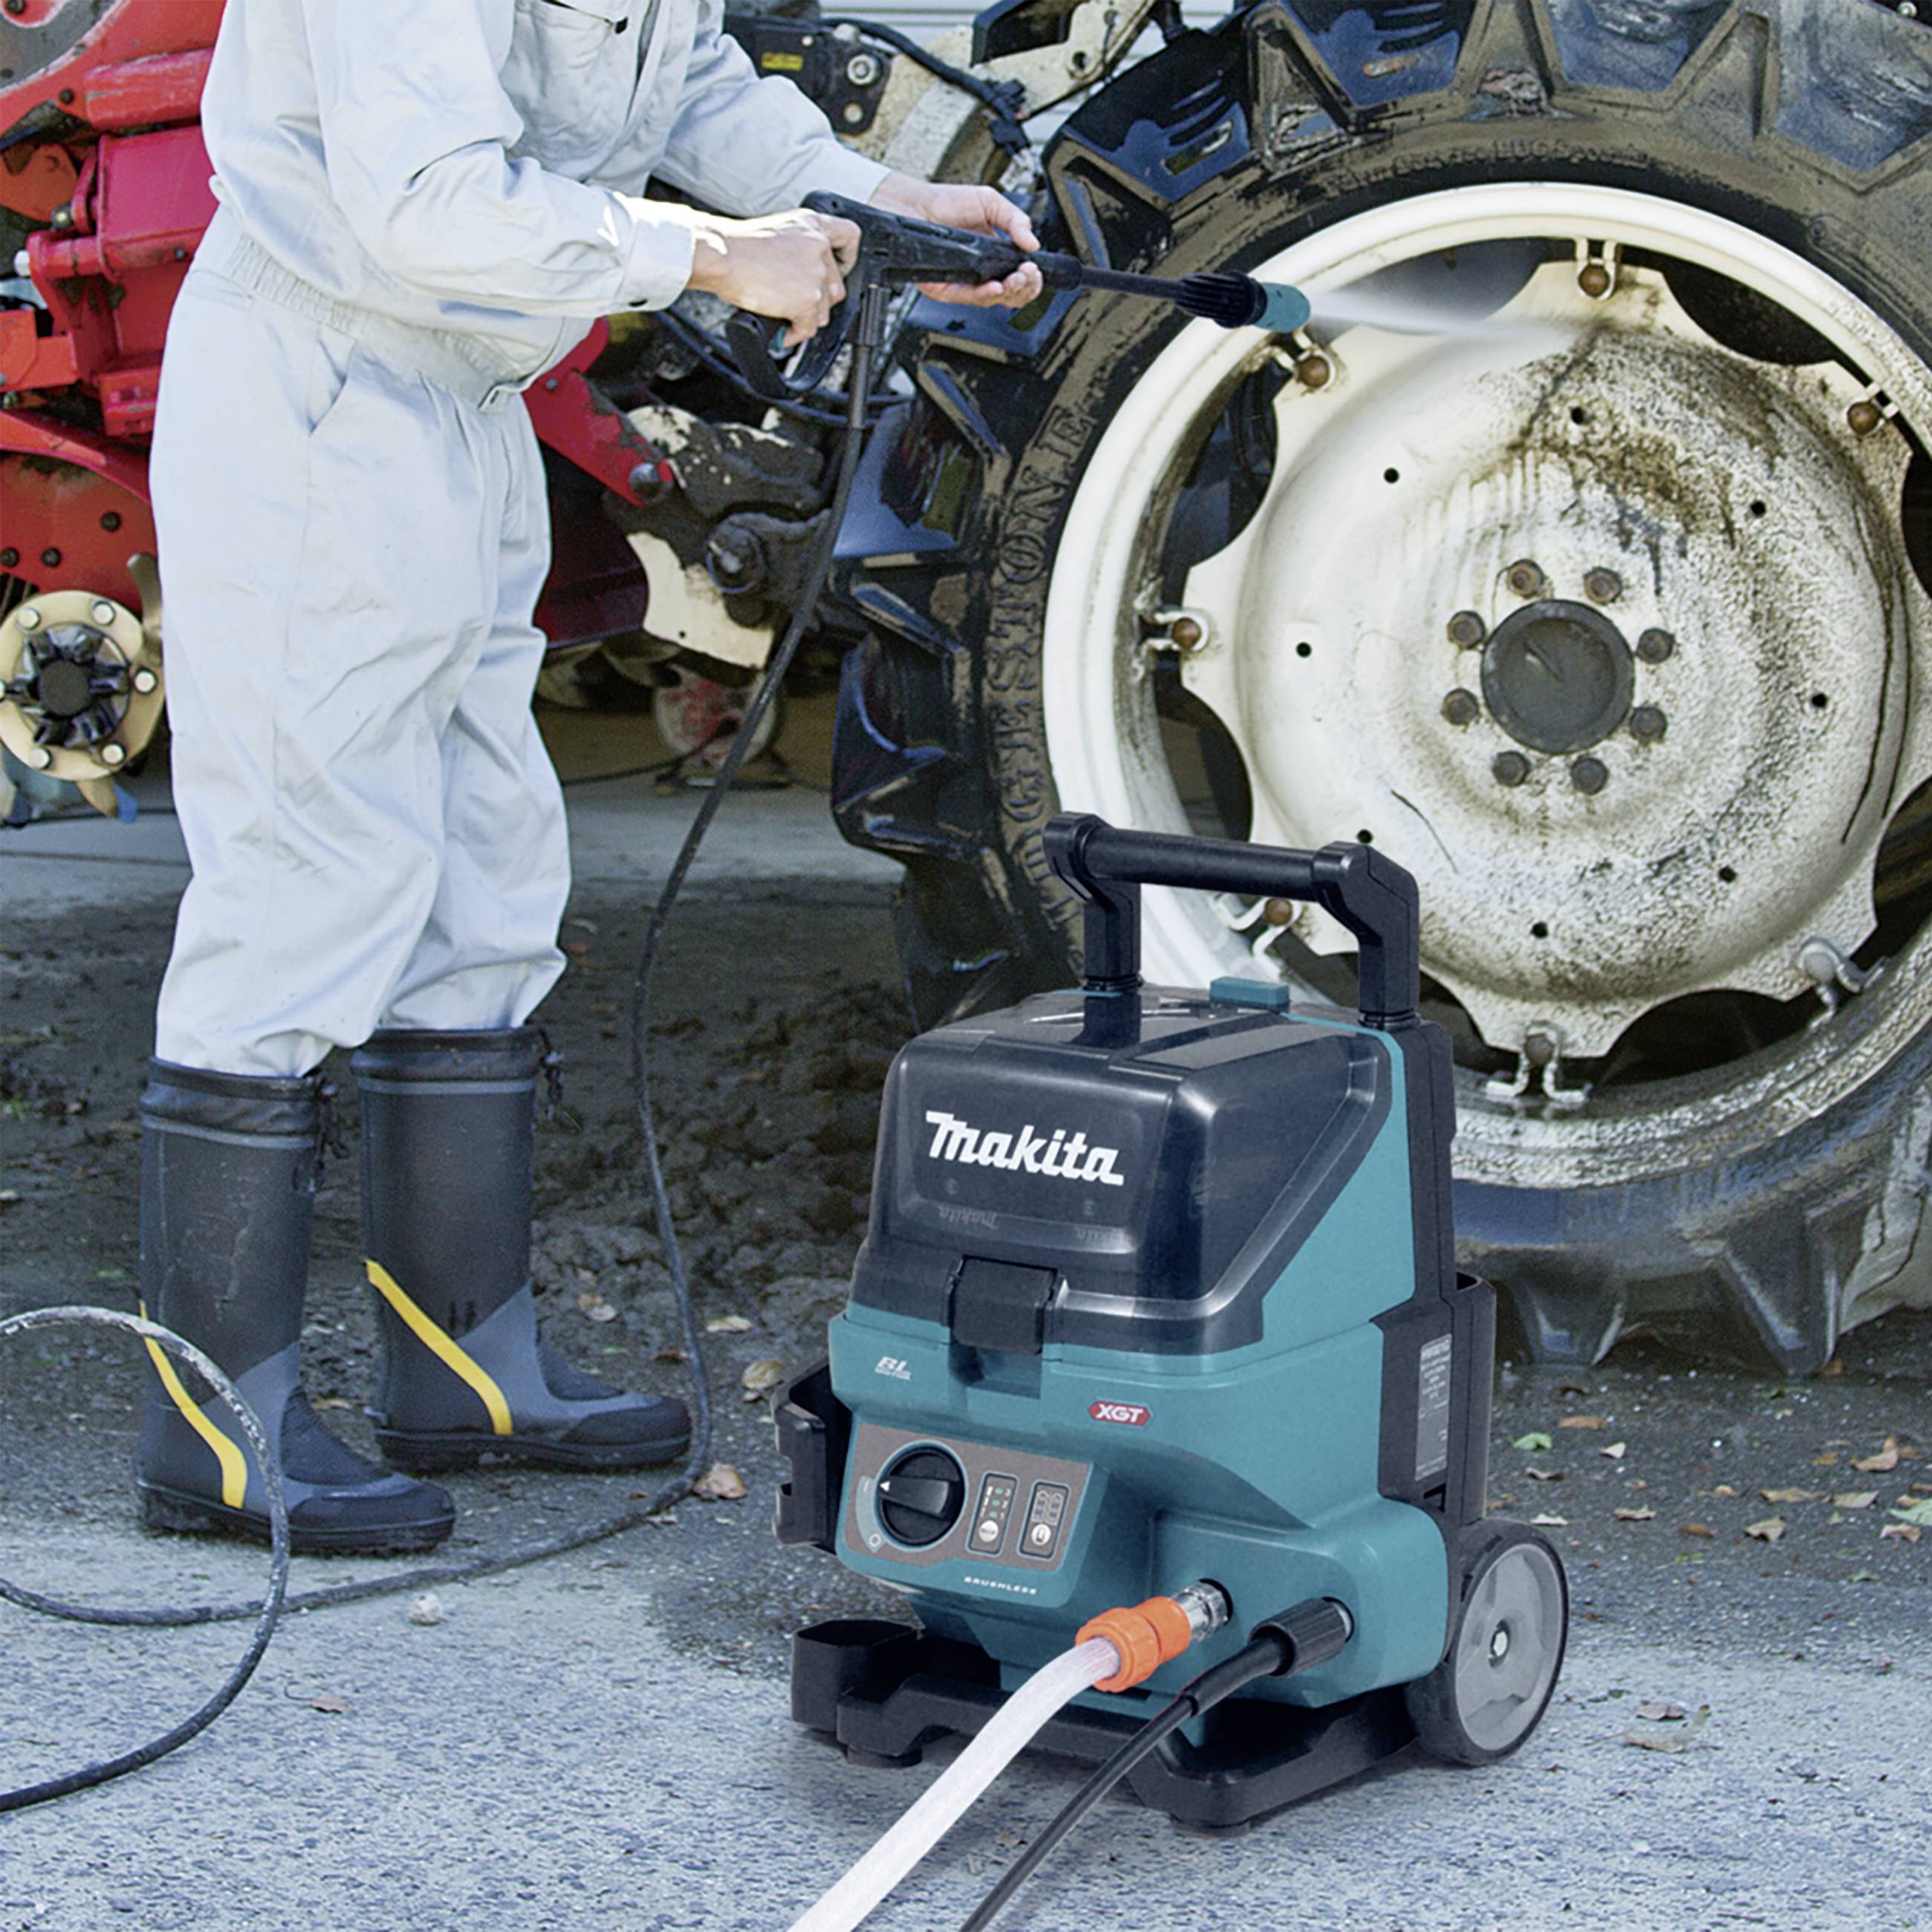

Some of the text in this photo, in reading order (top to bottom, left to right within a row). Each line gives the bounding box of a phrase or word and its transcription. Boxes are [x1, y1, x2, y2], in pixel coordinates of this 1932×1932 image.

[926, 1111, 1124, 1186] Makita
[877, 1356, 909, 1372] BL
[1095, 1403, 1144, 1423] XGT
[964, 1576, 1037, 1595] BRUSHLESS
